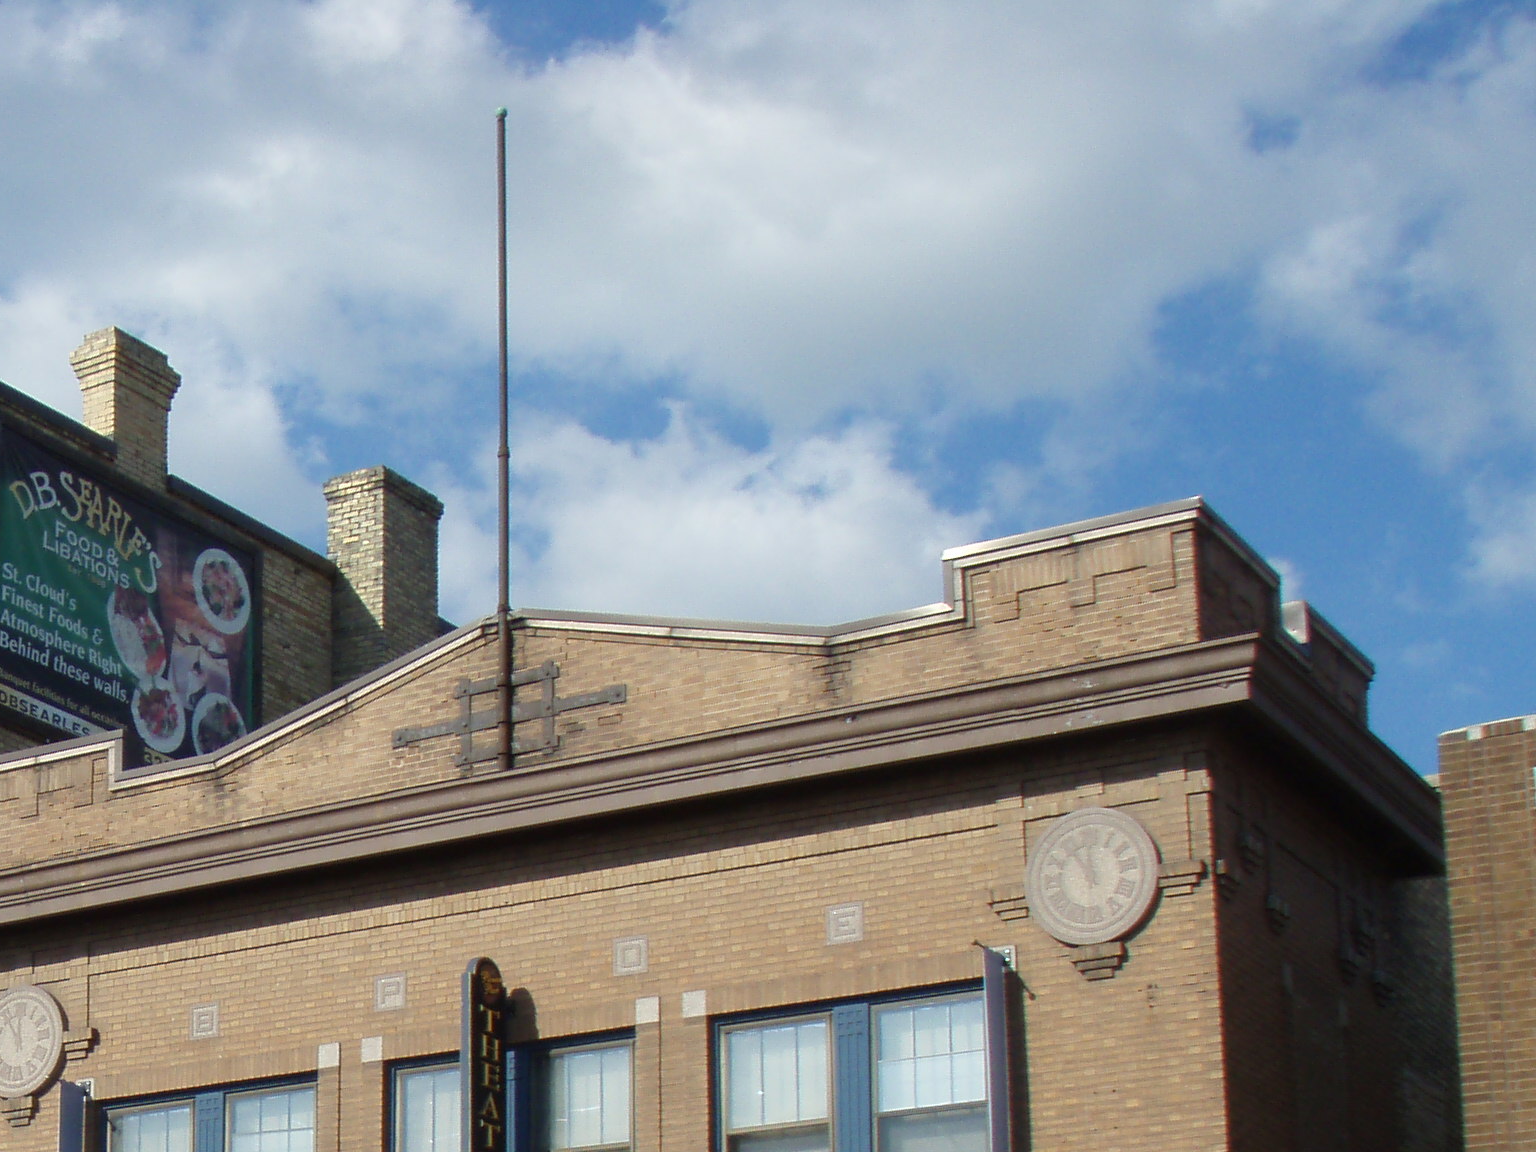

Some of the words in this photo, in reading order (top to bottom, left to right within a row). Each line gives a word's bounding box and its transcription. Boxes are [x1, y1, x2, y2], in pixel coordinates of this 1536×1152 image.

[43, 531, 130, 589] LIBATIONS
[55, 520, 103, 558] FOOD
[106, 549, 119, 568] &
[59, 471, 163, 593] SEARLE'S
[1, 585, 44, 619] Finest
[49, 607, 88, 640] Foods
[92, 628, 104, 645] &
[2, 562, 22, 584] St.
[26, 575, 77, 611] Cloud's
[0, 609, 85, 659] Atmosphere
[89, 649, 123, 677] Right
[0, 631, 50, 667] Behind
[53, 655, 91, 685] these
[94, 676, 129, 704] walls.
